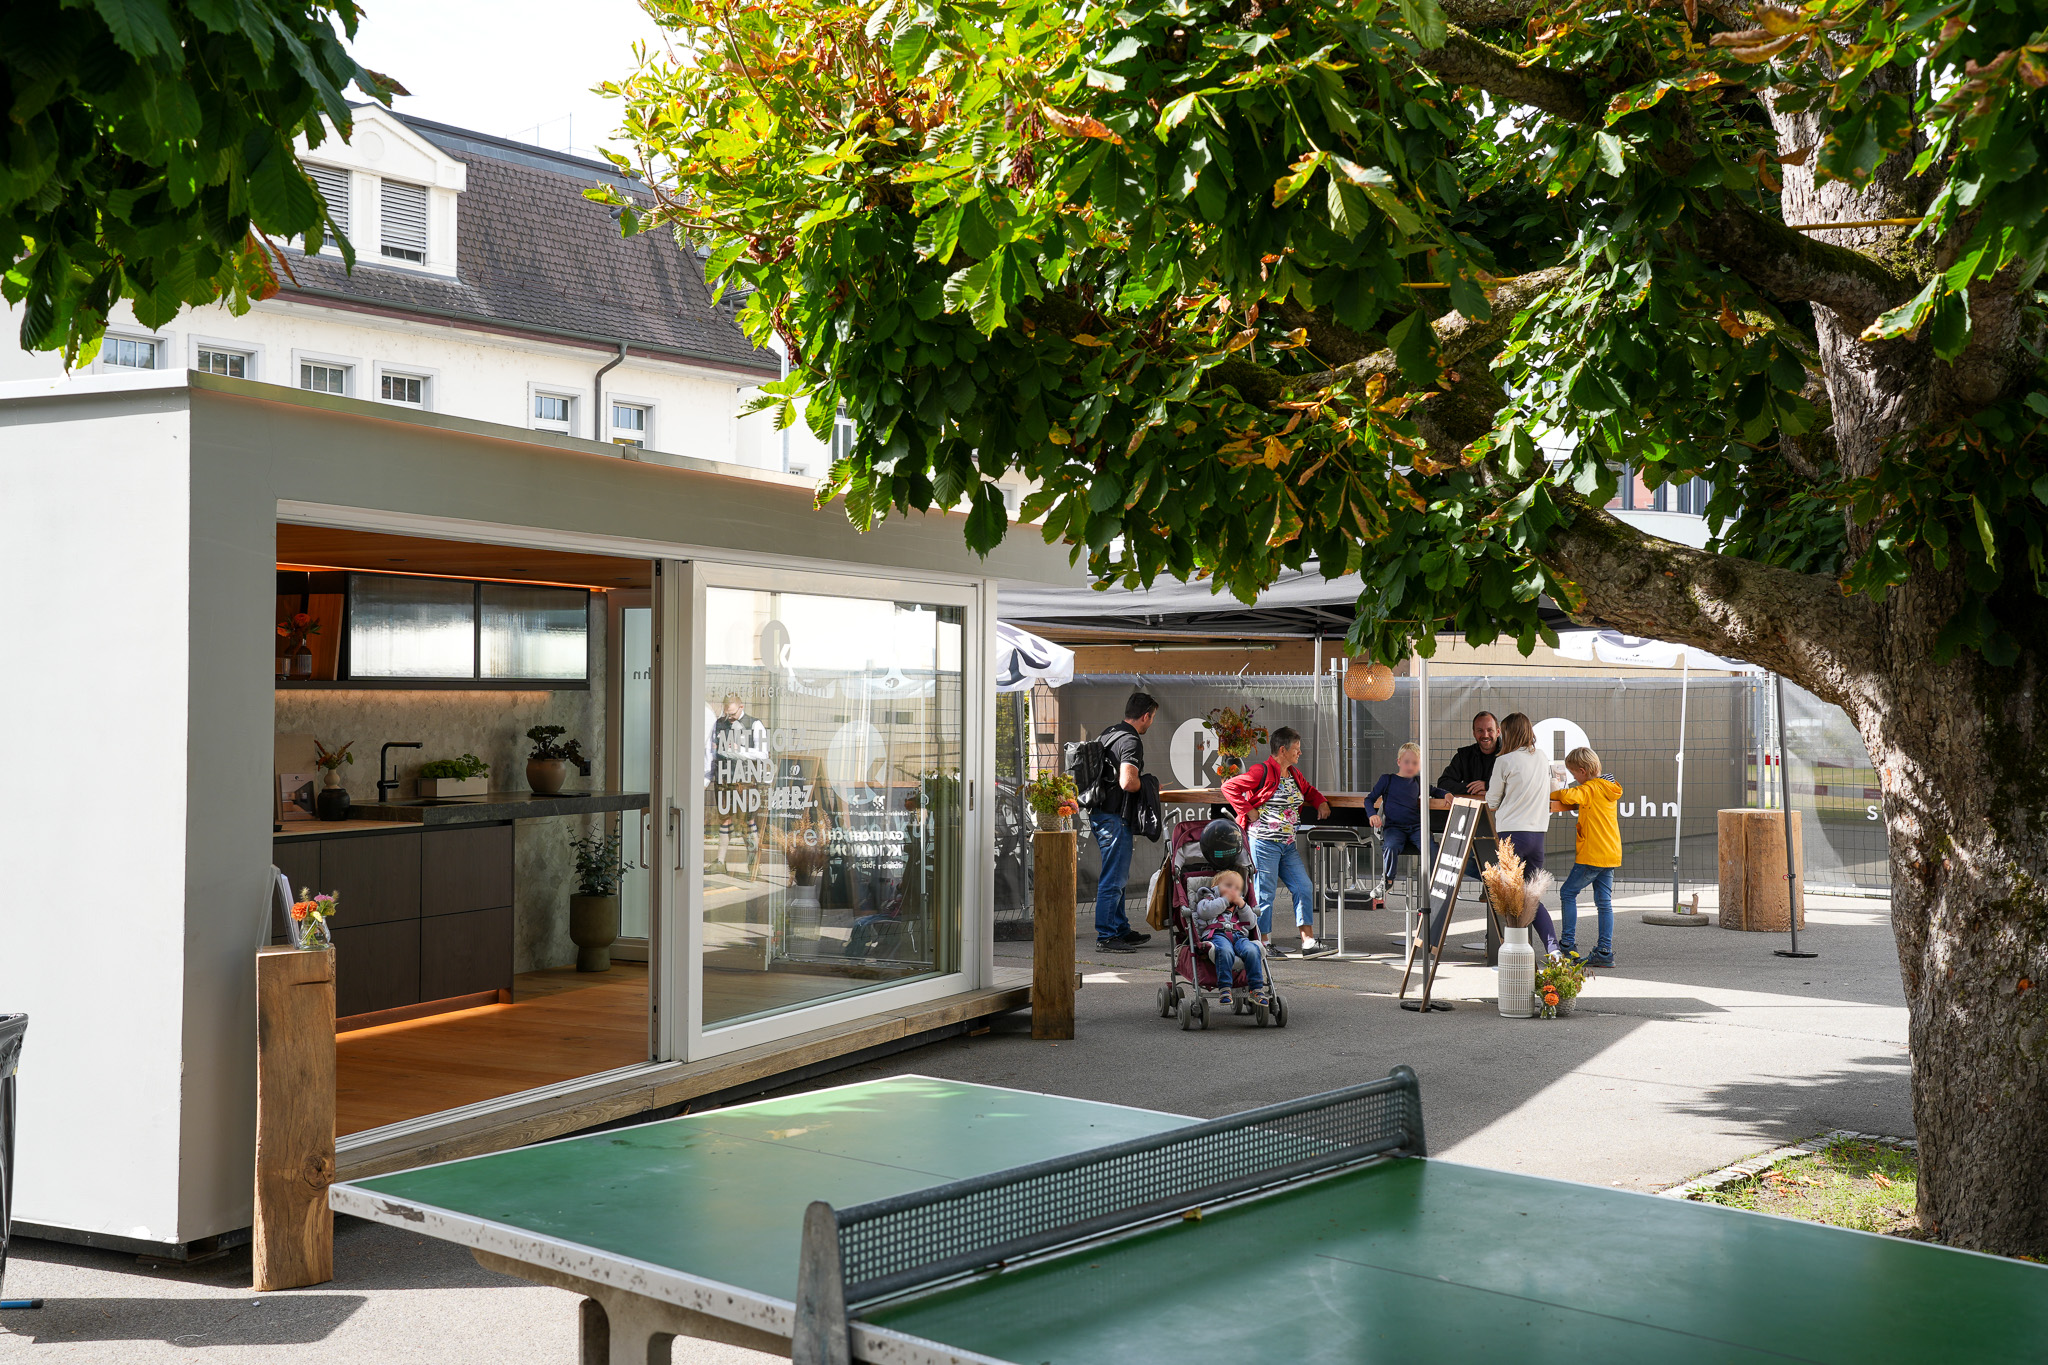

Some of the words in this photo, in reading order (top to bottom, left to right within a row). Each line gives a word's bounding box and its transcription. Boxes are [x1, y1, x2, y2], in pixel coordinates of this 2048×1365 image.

[717, 729, 753, 755] MIT
[758, 727, 811, 755] HOLZ,
[717, 758, 775, 785] HAND
[717, 788, 761, 815] UND
[767, 785, 819, 811] HERZ.
